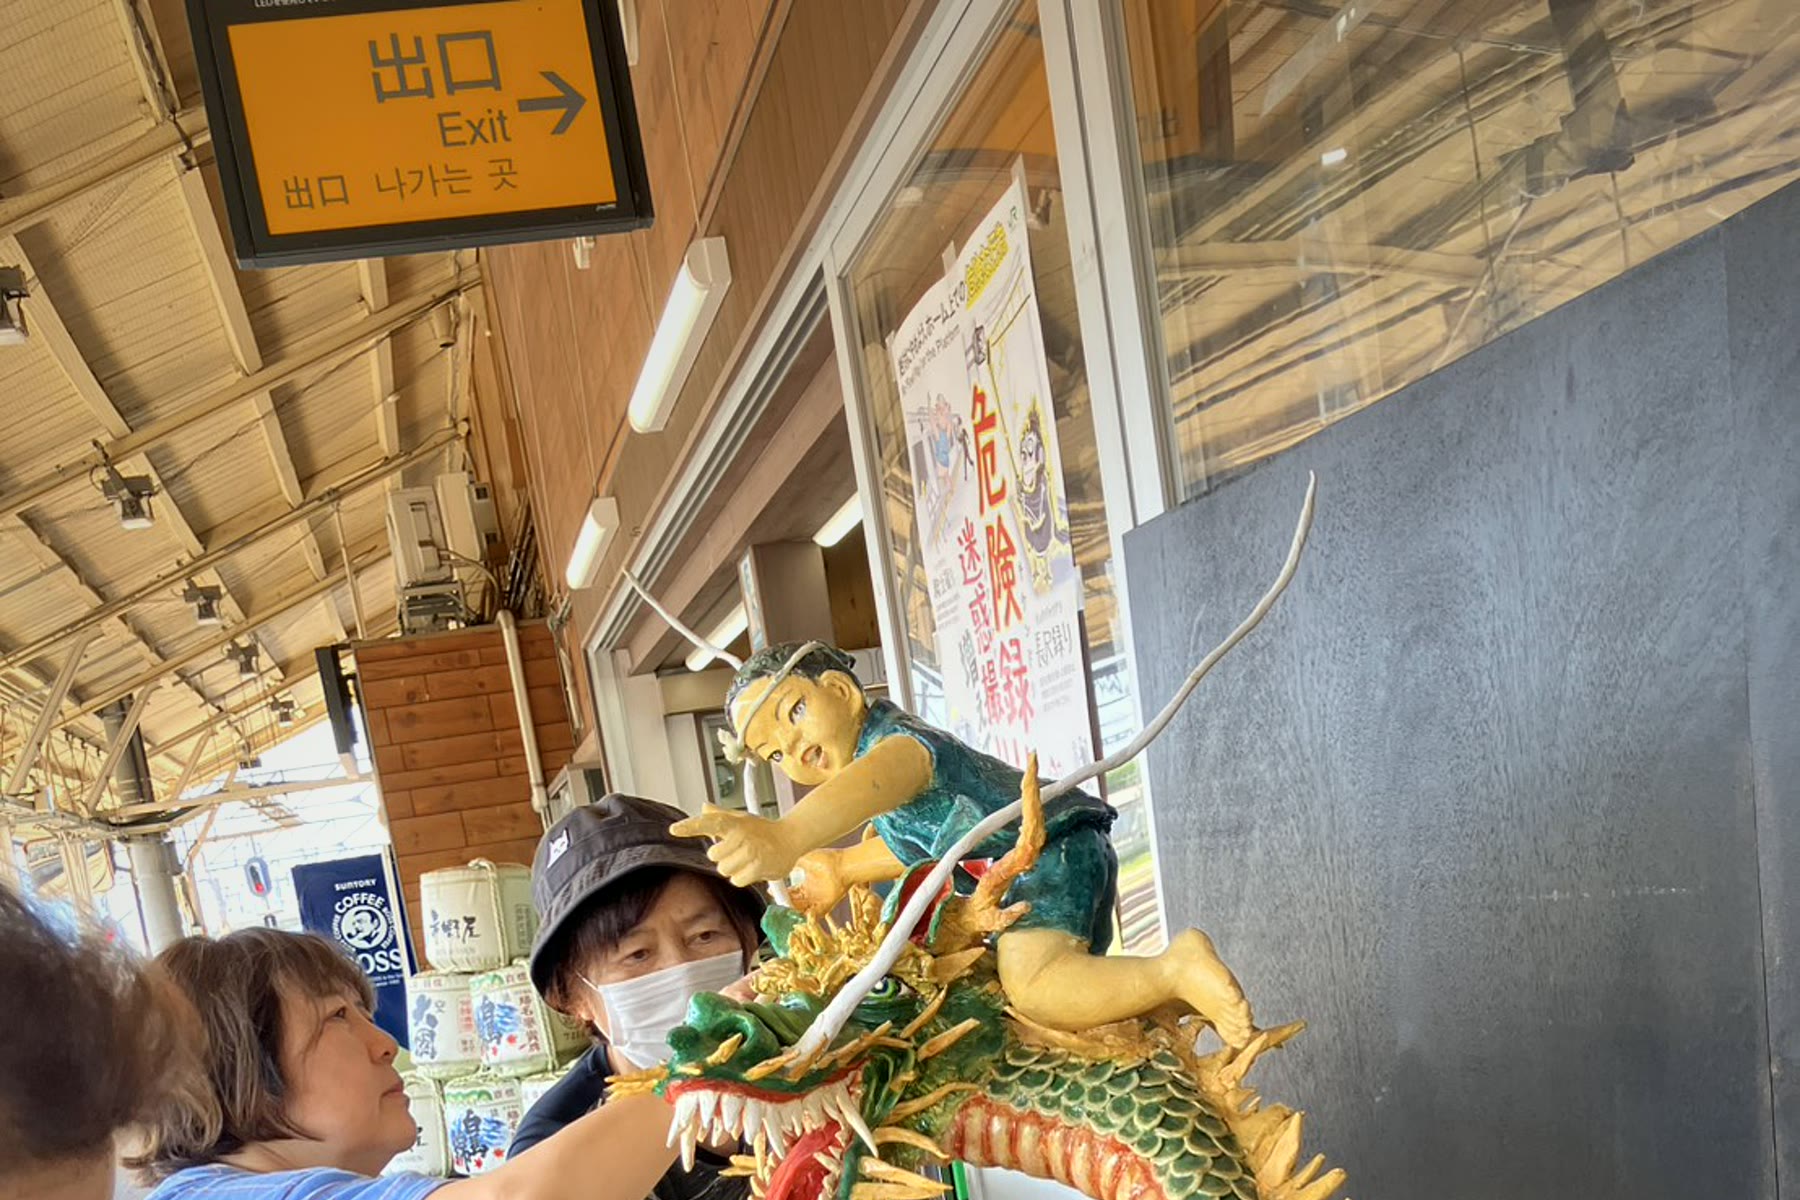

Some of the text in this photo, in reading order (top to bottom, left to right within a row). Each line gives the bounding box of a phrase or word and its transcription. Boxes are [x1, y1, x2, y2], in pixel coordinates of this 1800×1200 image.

[368, 30, 502, 103] 出口
[437, 109, 512, 147] Exit
[283, 175, 350, 209] 出口
[375, 157, 518, 199] 나가는 곳
[334, 878, 377, 892] SUNTORY
[334, 893, 386, 914] COFFEE
[356, 948, 403, 975] OSS
